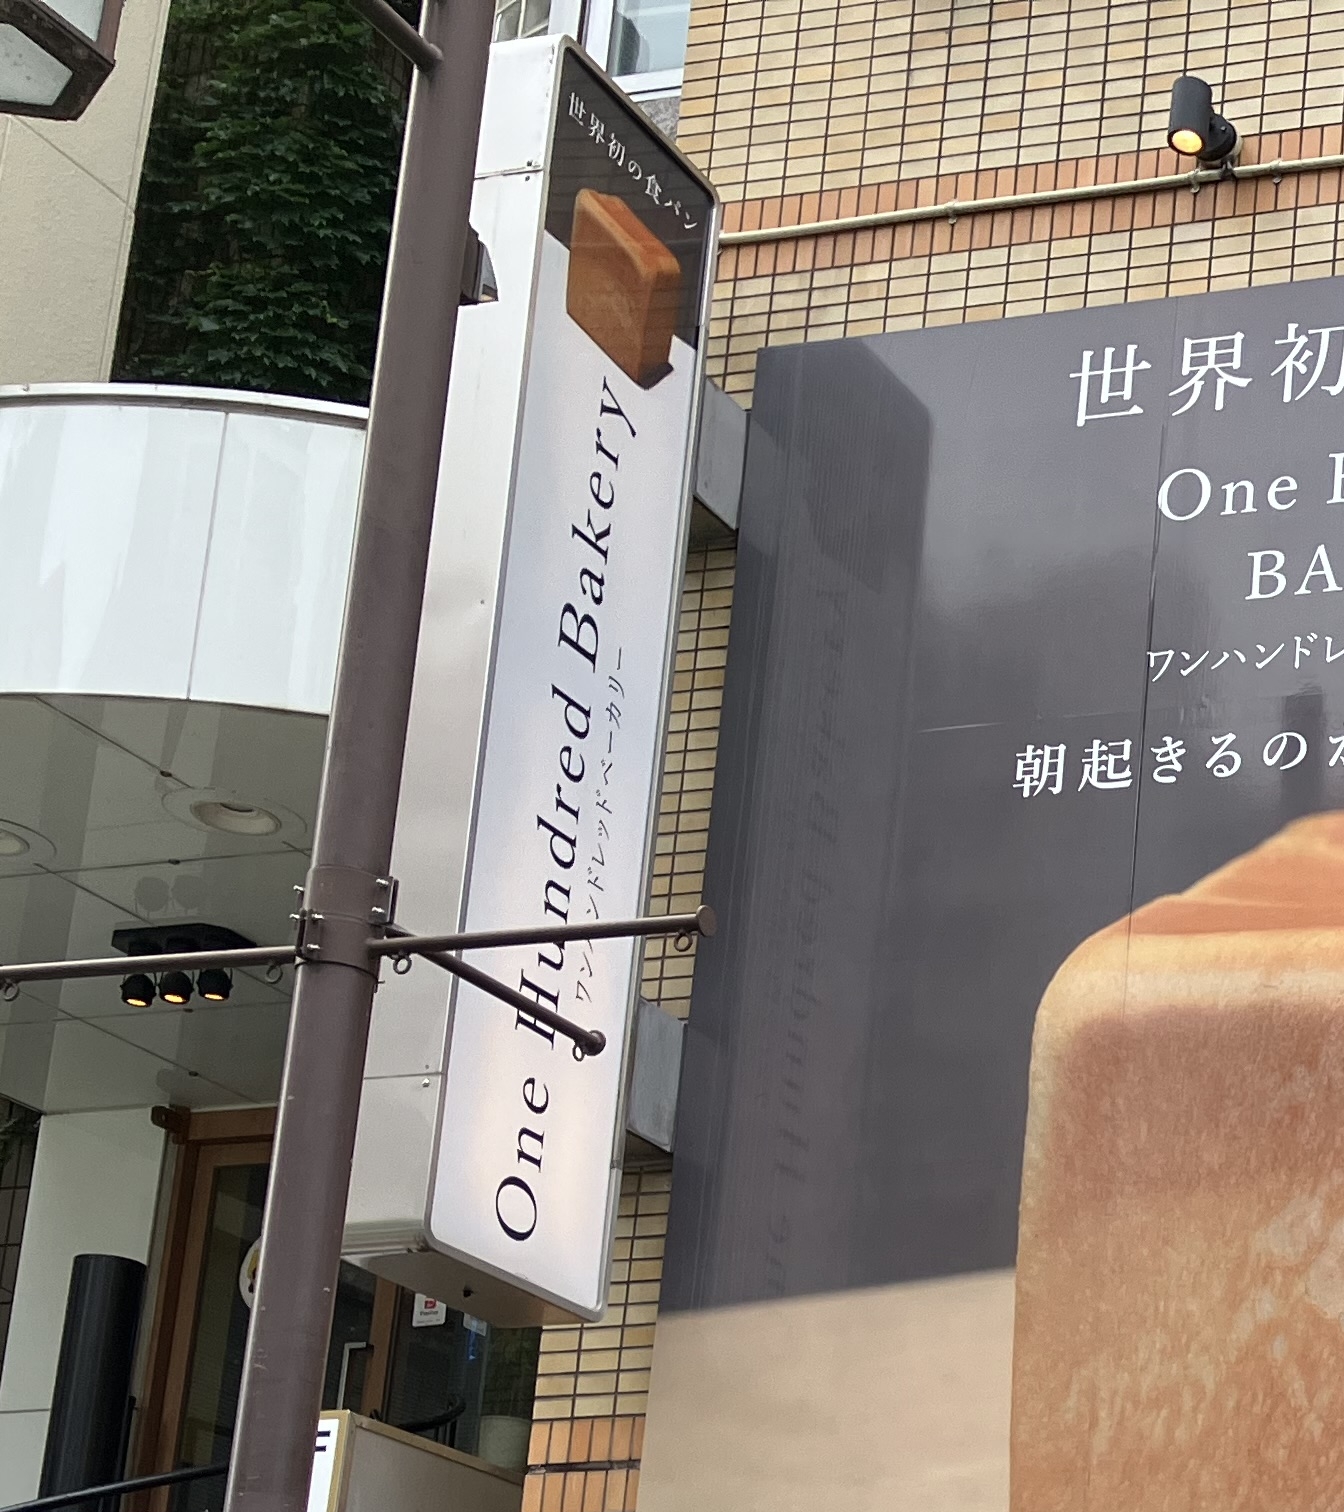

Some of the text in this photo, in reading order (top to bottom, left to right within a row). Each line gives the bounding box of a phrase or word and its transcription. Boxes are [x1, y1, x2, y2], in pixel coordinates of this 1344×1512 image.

[569, 92, 697, 229] 世界初の食パン
[1157, 463, 1299, 525] One
[495, 1075, 549, 1243] One
[558, 375, 641, 676] Bakery
